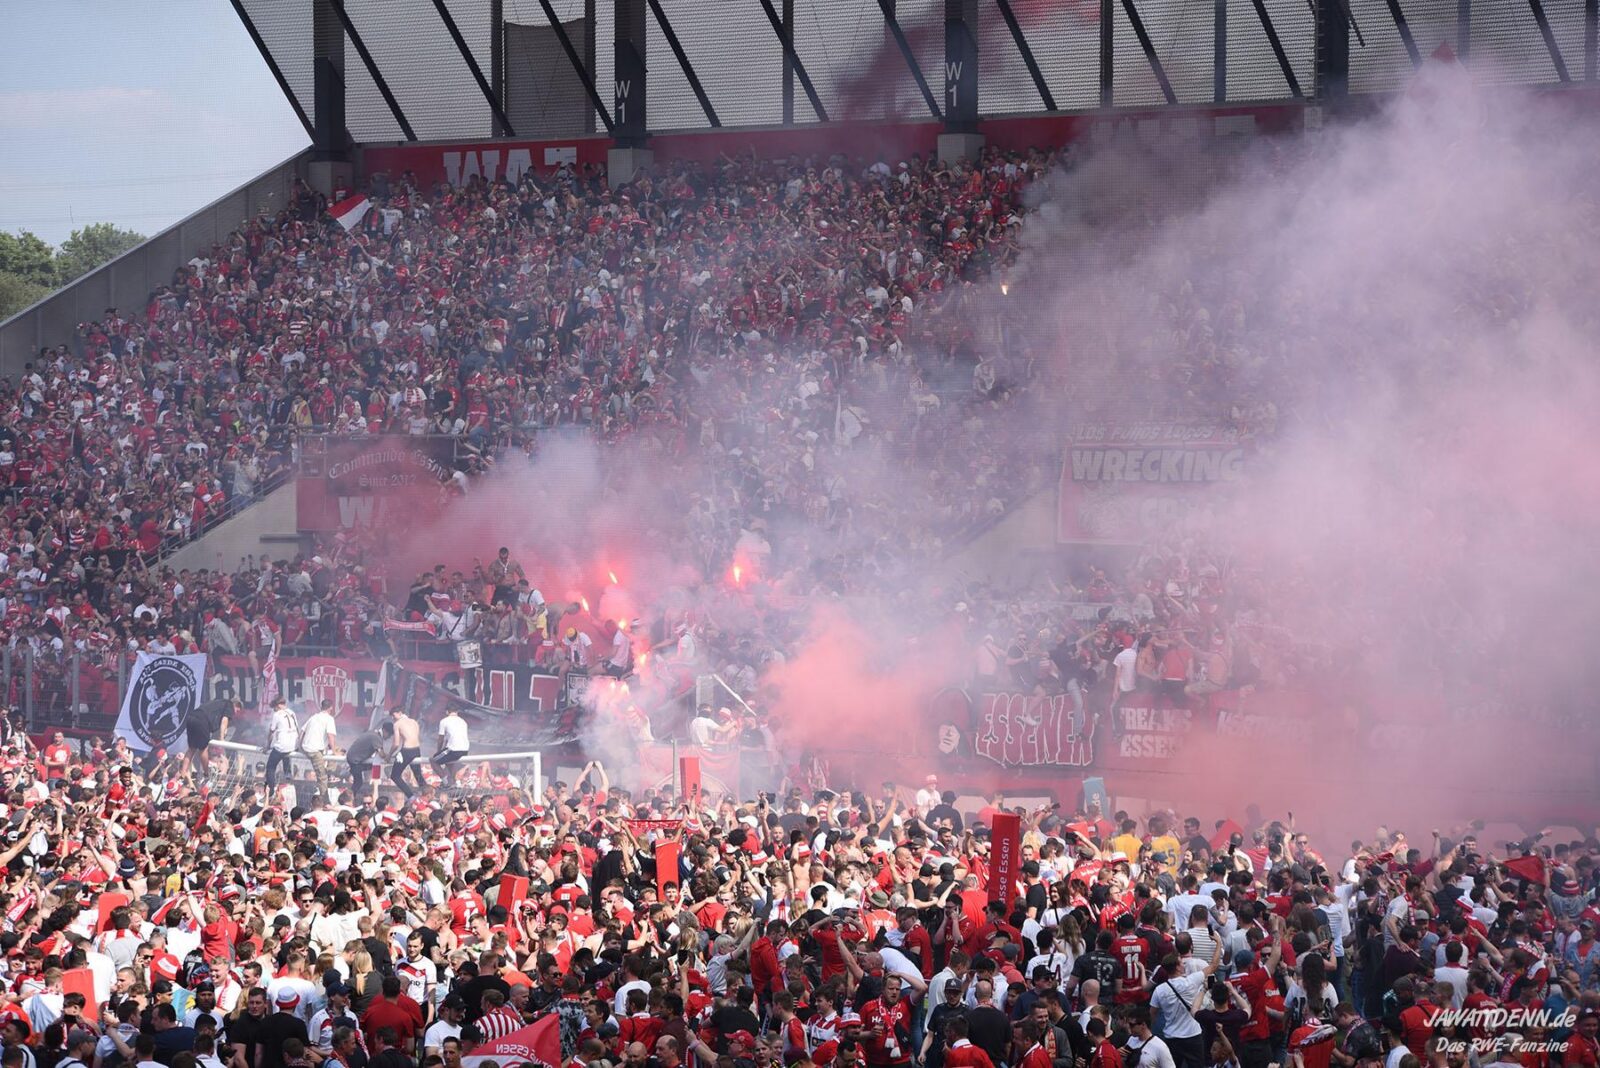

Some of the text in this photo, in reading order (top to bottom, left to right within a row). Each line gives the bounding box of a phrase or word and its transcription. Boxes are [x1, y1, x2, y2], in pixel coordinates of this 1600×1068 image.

[946, 62, 962, 80] W
[615, 80, 630, 98] W
[949, 85, 958, 107] 1
[618, 102, 626, 123] 1
[1072, 450, 1244, 482] WRECKING
[999, 837, 1011, 873] Essen
